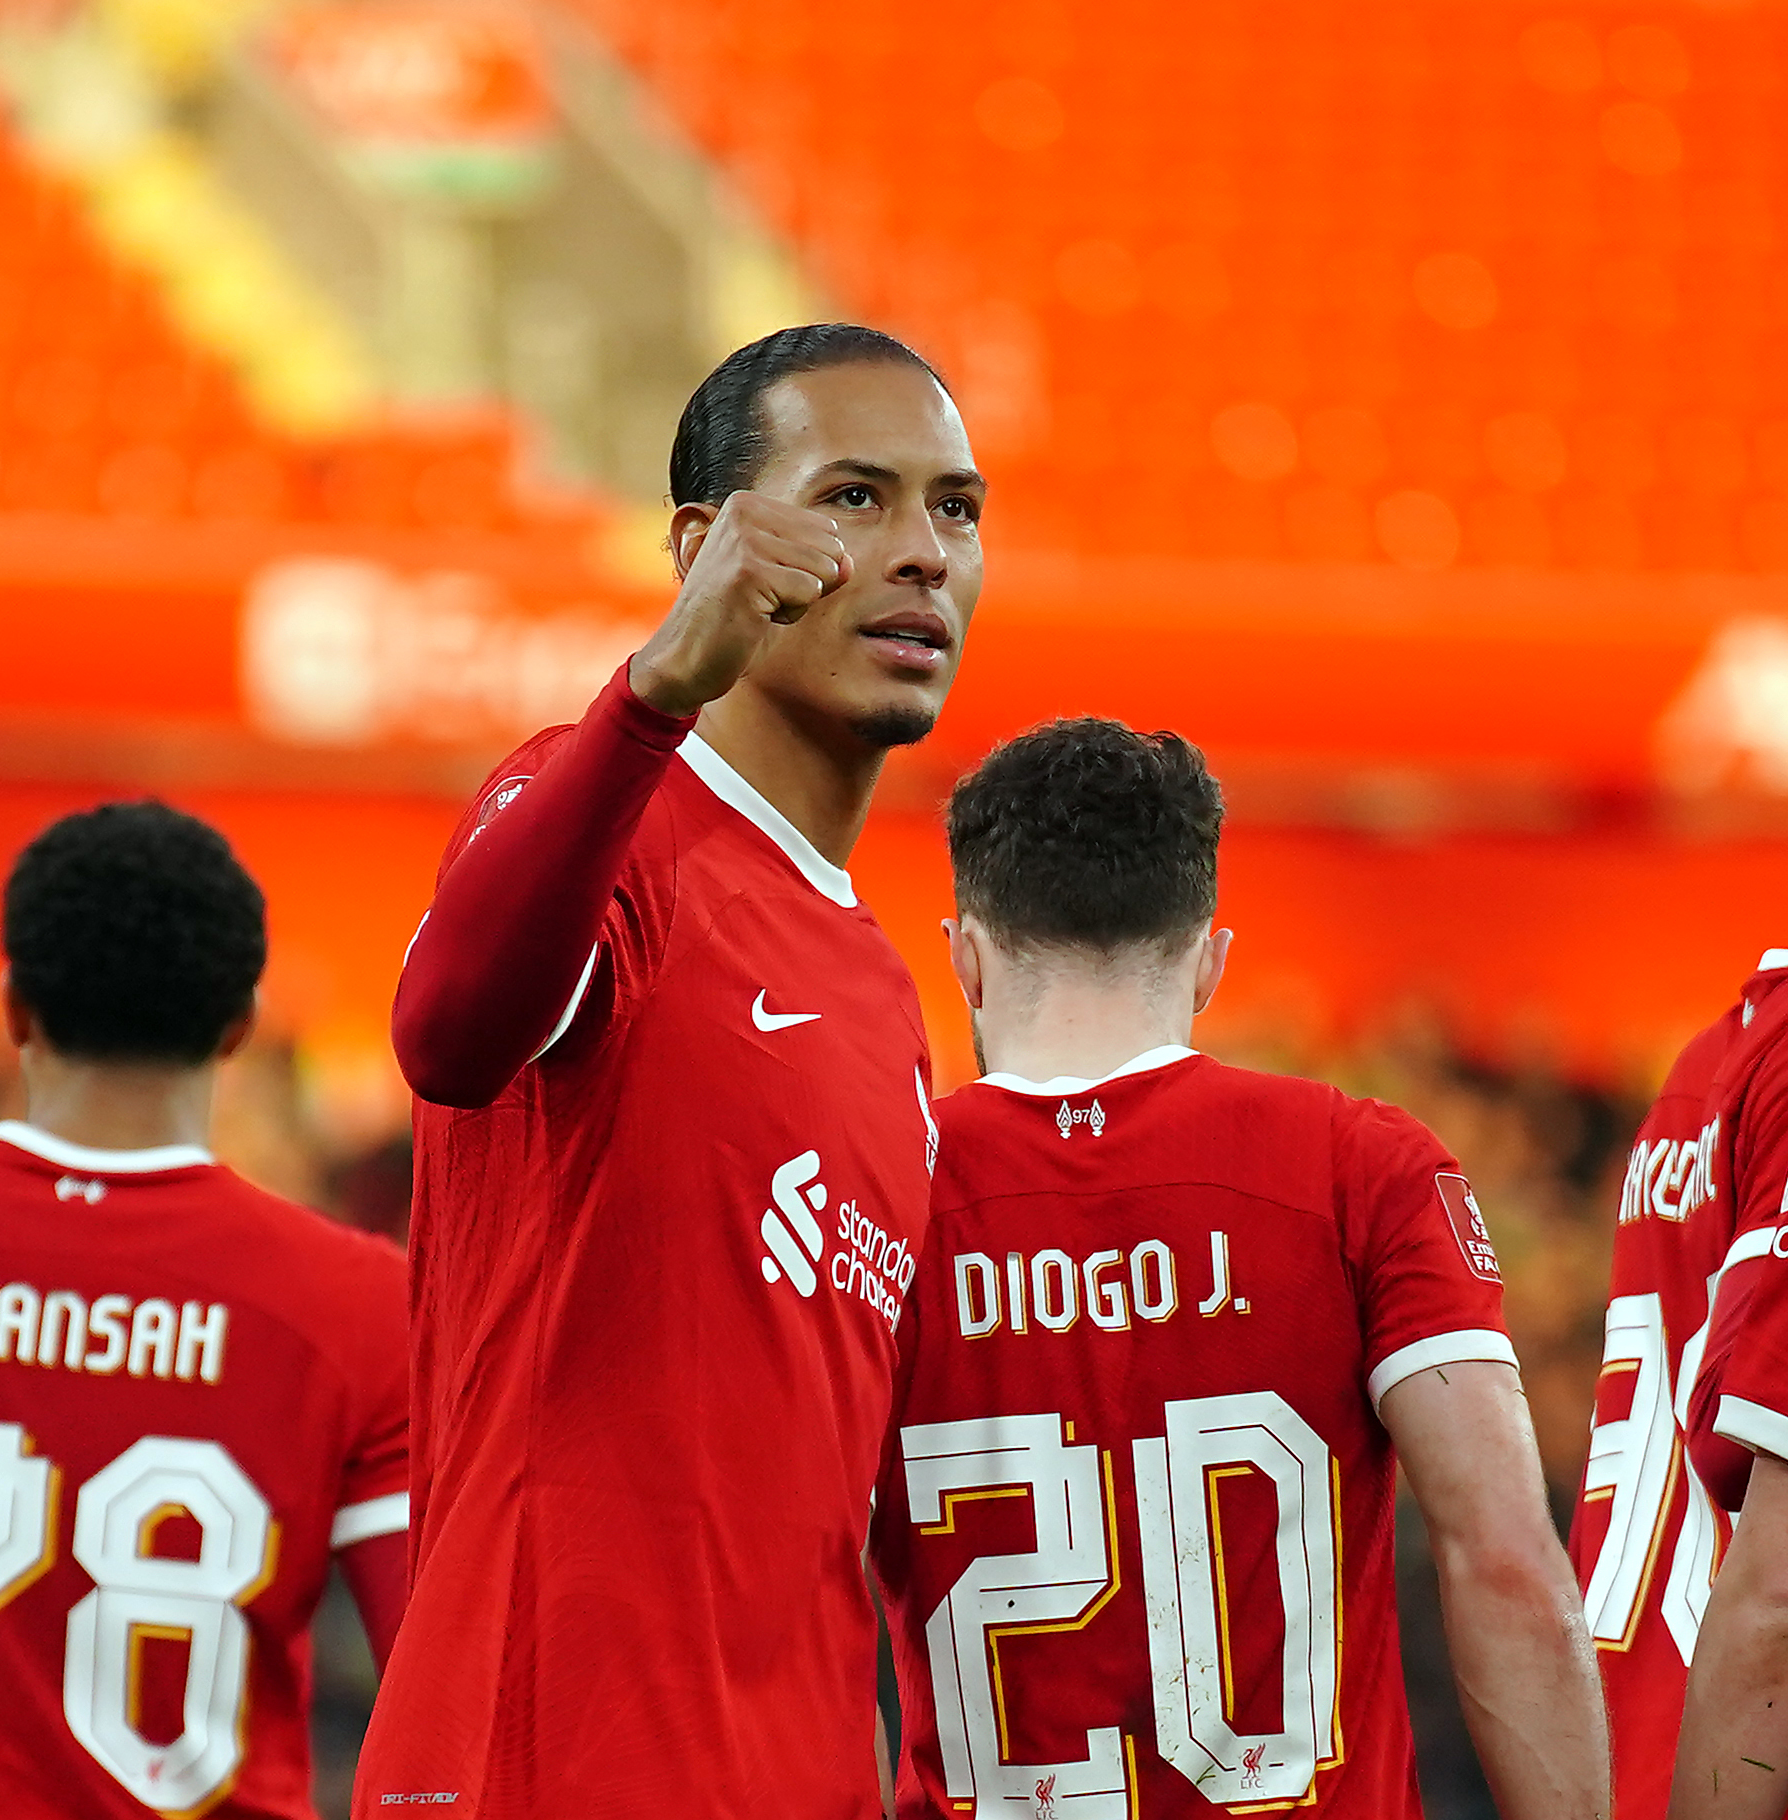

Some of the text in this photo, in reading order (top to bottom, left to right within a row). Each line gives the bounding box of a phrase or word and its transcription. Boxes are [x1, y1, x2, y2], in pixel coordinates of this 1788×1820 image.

[1072, 1109, 1090, 1124] 97
[953, 1231, 1250, 1340] DIOGO J.
